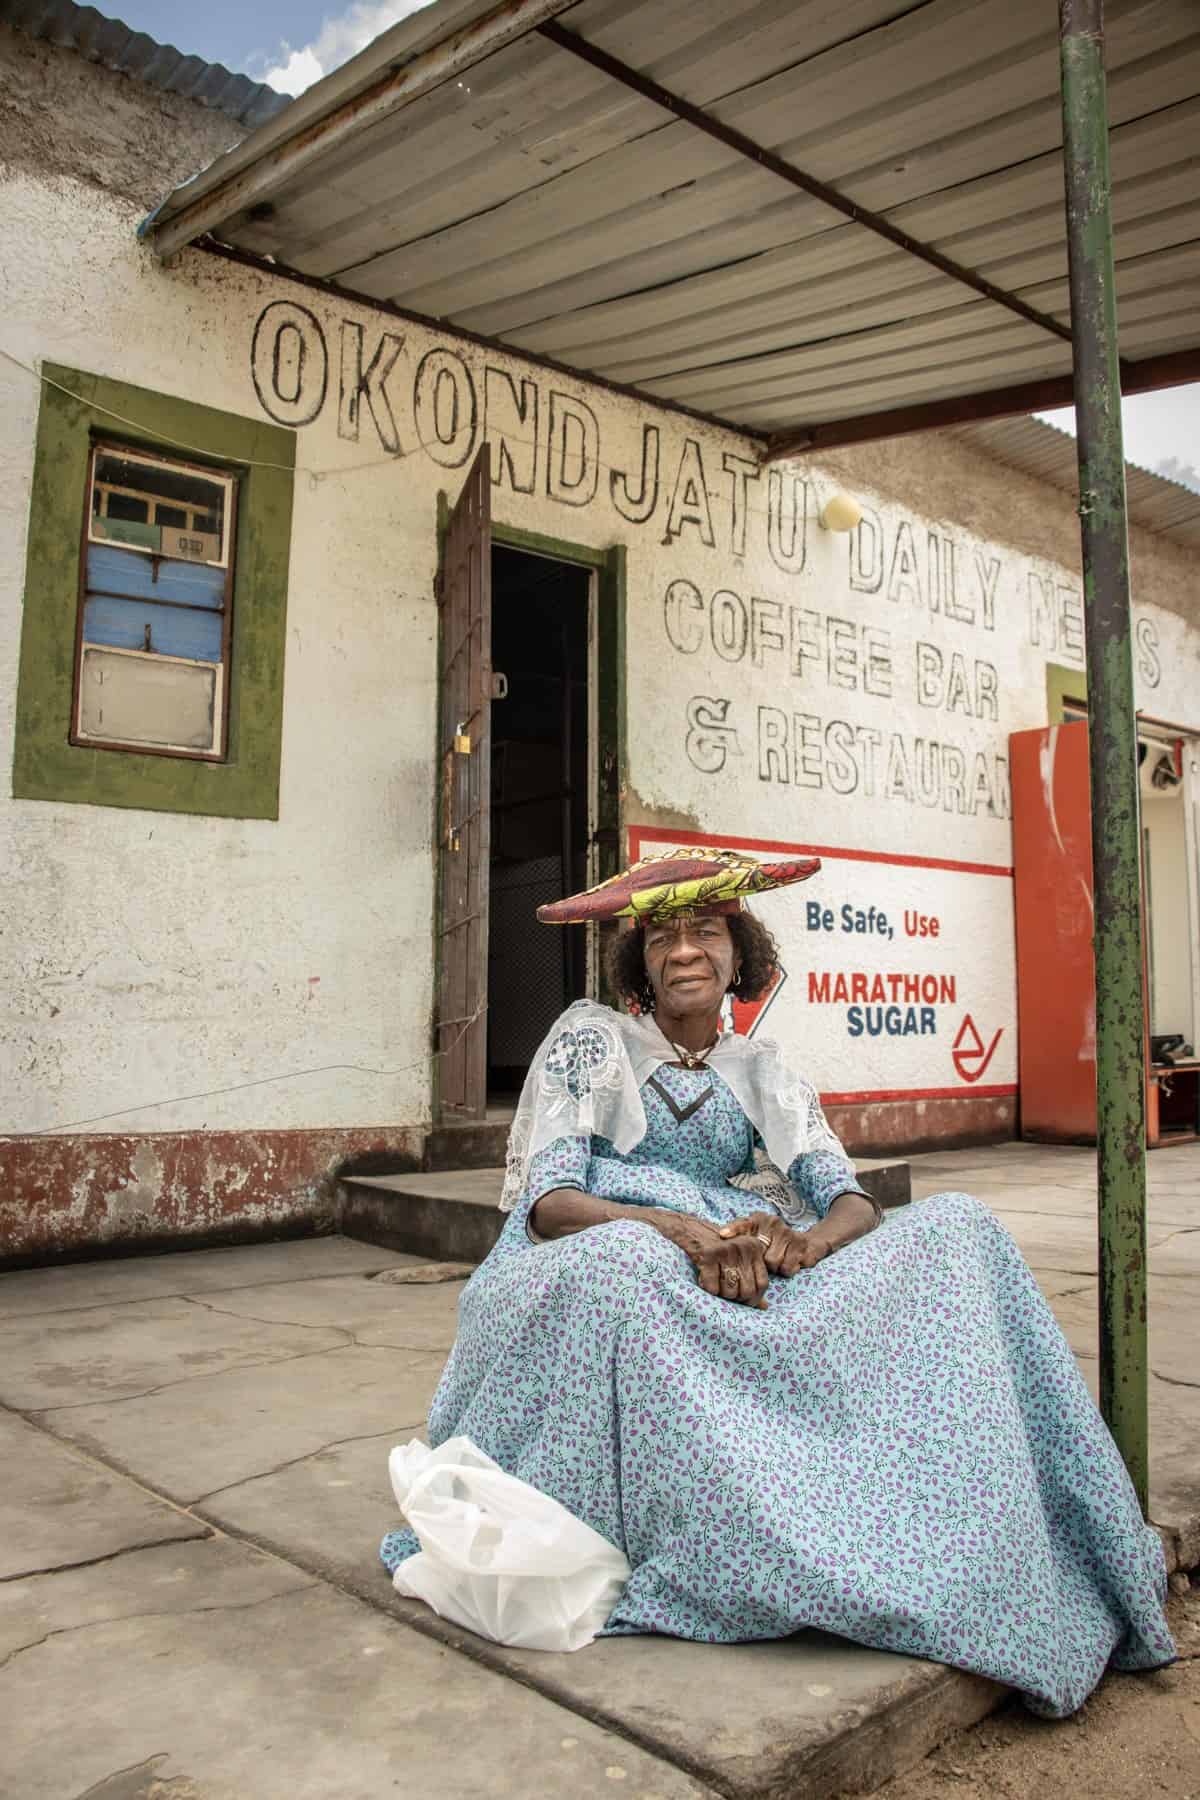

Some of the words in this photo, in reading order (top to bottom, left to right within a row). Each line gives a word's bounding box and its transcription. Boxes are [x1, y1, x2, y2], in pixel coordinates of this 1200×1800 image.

[251, 301, 807, 575] OKONDJATU
[848, 508, 1002, 631] DAILY
[1027, 572, 1162, 689] NES
[664, 579, 894, 698] COFFEE
[915, 642, 1001, 723] BAR
[685, 695, 742, 774] &
[757, 706, 1012, 821] RESTAURAN
[806, 901, 833, 931] Be
[841, 904, 894, 940] Safe,
[904, 910, 940, 937] Use
[808, 972, 956, 1003] MARATHON
[847, 1007, 937, 1037] SUGAR
